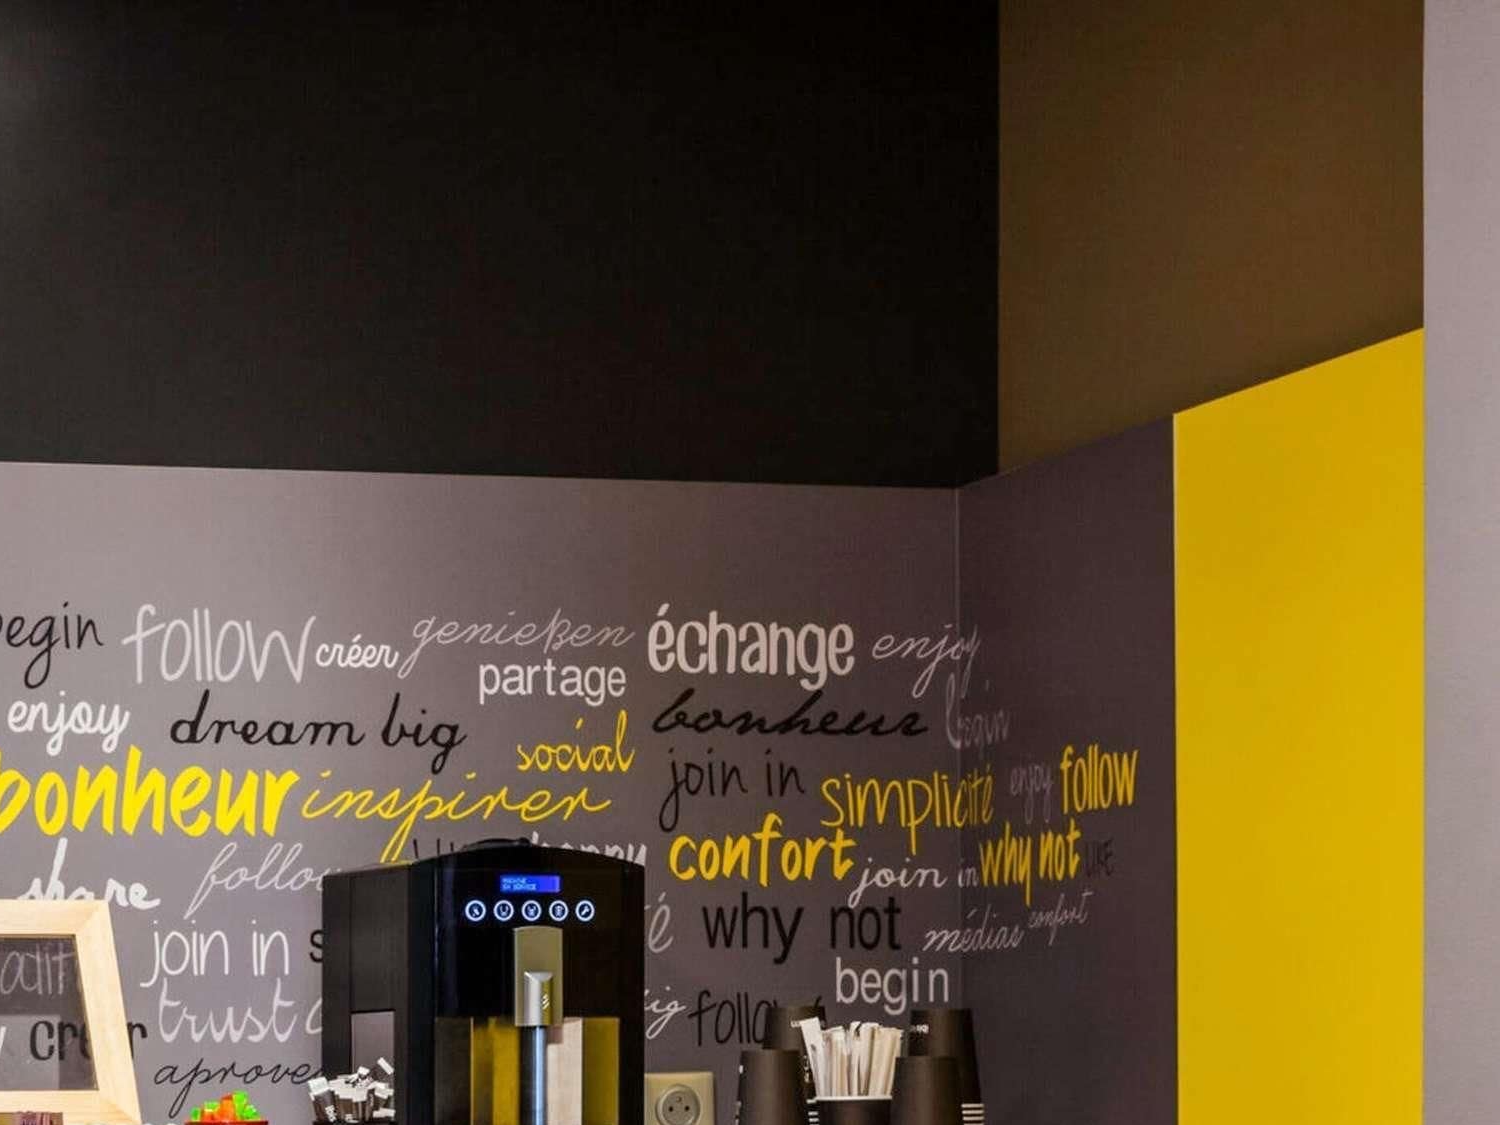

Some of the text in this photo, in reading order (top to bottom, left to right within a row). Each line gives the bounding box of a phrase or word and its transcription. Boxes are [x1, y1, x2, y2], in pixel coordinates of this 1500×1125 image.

[122, 604, 316, 684] follow
[316, 634, 398, 669] créer
[647, 603, 854, 690] échange
[872, 623, 981, 698] enjoy
[479, 659, 626, 706] partage
[653, 688, 928, 736] bonheur
[8, 691, 130, 756] enjoy
[170, 689, 467, 775] dream big
[517, 709, 635, 774] social
[658, 747, 805, 831] join in
[820, 763, 994, 854] simplicité
[1060, 744, 1138, 814] follow
[302, 771, 610, 864] inspirer
[669, 812, 856, 887] confort
[183, 841, 324, 919] follo
[848, 857, 980, 908] join in
[979, 818, 1081, 906] why not
[140, 920, 229, 987] join
[251, 920, 289, 976] in
[702, 892, 804, 964] why
[830, 897, 903, 950] not
[924, 905, 1024, 952] médias
[158, 977, 298, 1043] trust
[644, 986, 686, 1040] ig
[687, 989, 821, 1048] follo
[836, 957, 948, 1016] begin
[153, 1057, 323, 1119] aprove
